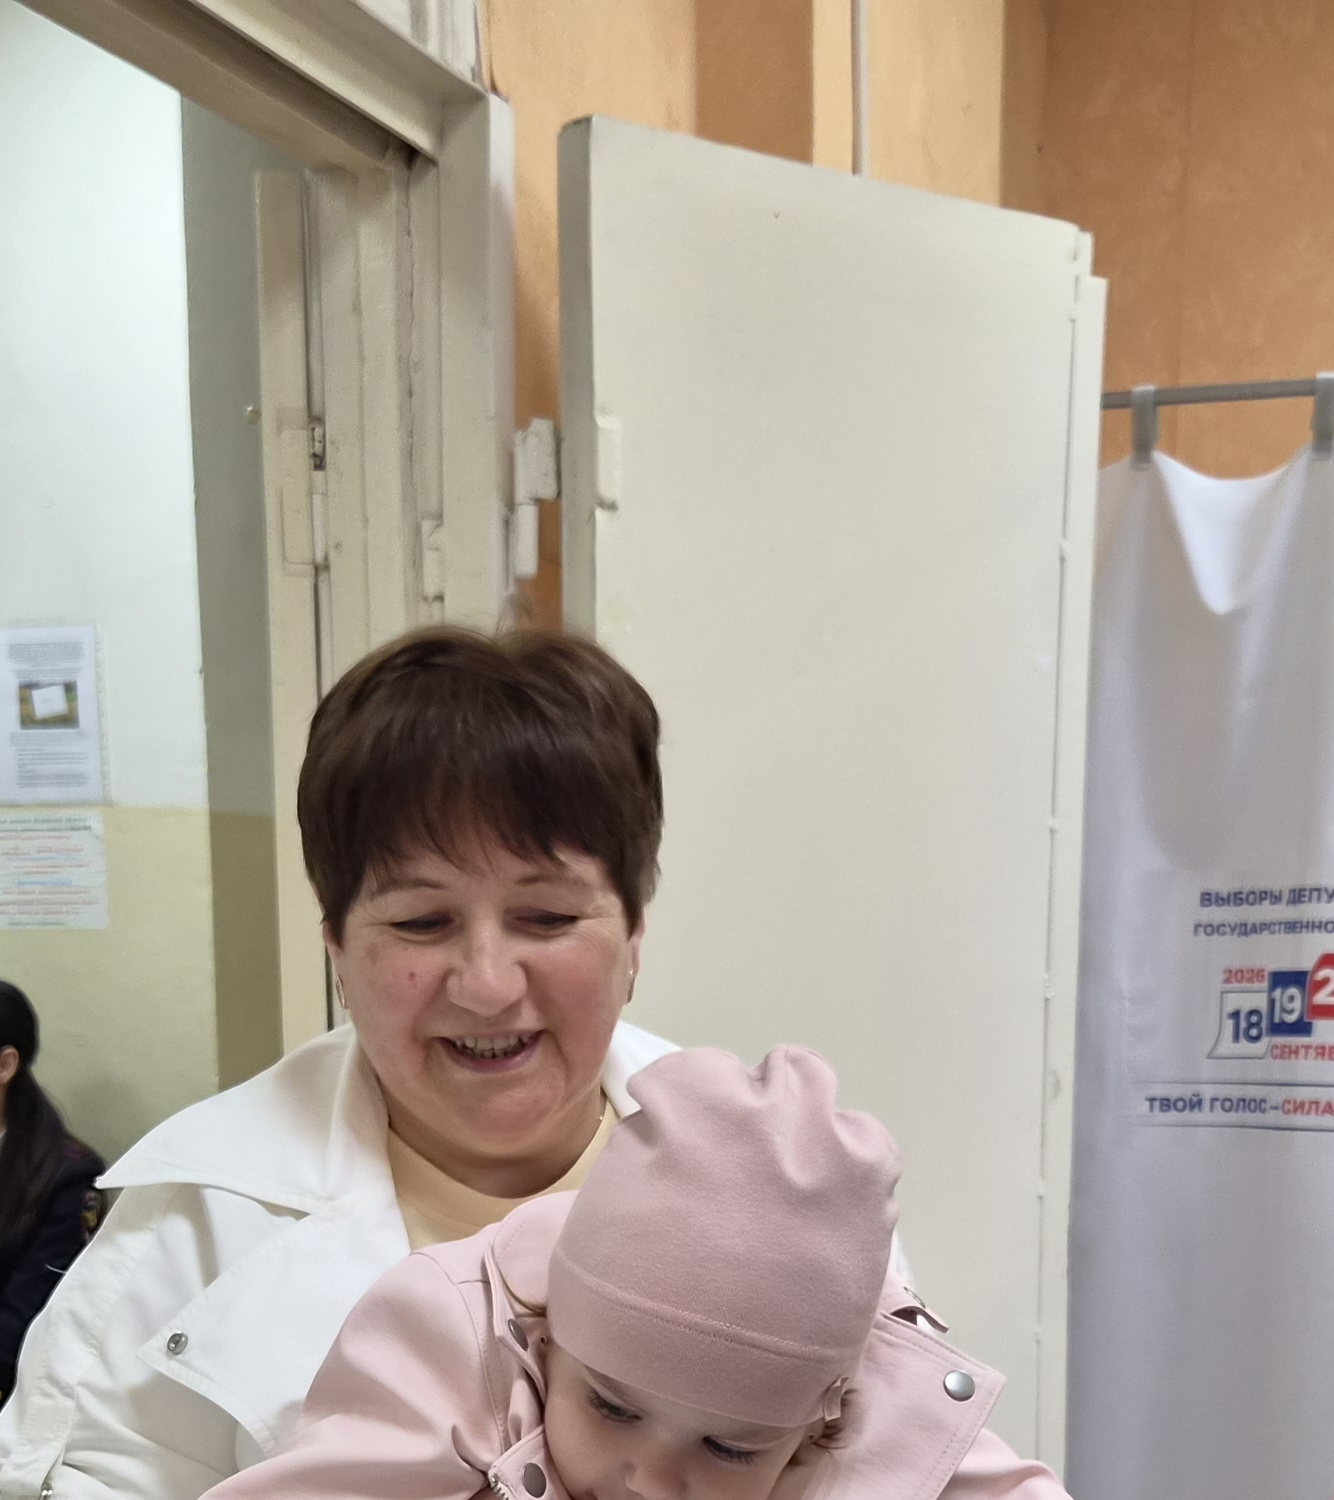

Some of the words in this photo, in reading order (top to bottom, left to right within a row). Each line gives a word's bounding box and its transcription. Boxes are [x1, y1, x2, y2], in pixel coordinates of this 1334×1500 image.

[1199, 889, 1282, 908] ВЫБОРЫ
[1222, 968, 1266, 984] 2026
[1228, 1009, 1264, 1044] 18
[1272, 987, 1301, 1021] 19
[1144, 1093, 1202, 1114] ТВОЙ
